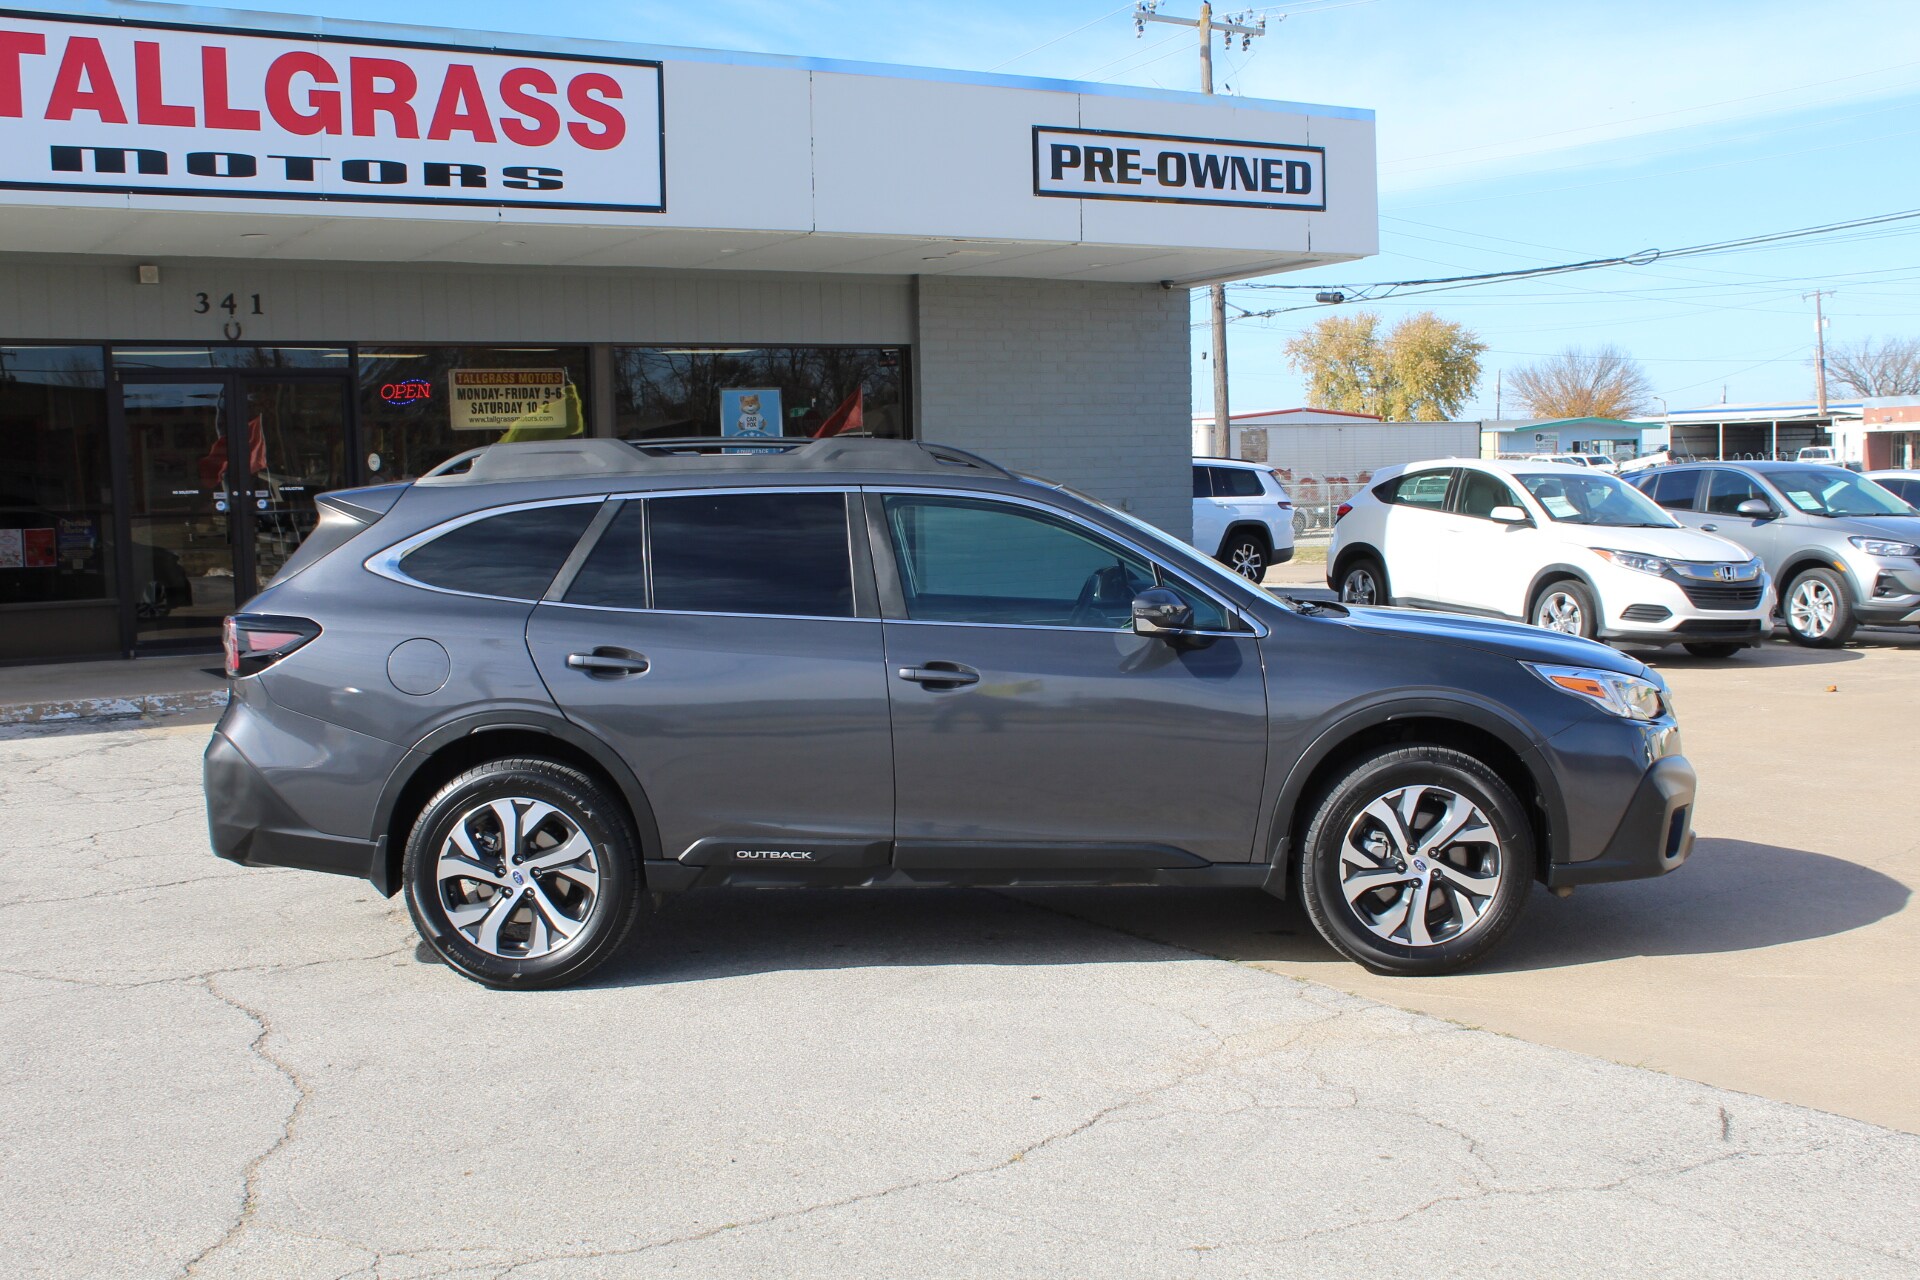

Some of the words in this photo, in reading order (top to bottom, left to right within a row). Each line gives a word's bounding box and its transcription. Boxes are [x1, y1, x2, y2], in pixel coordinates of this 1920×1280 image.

[0, 30, 626, 150] TALLGRASS
[1050, 144, 1312, 195] PRE-OWNED
[457, 373, 515, 385] TALLGRASS
[519, 373, 561, 384] MOTORS
[380, 384, 431, 400] OPEN
[471, 402, 522, 414] SATURDAY
[736, 850, 812, 859] OUTBACK
